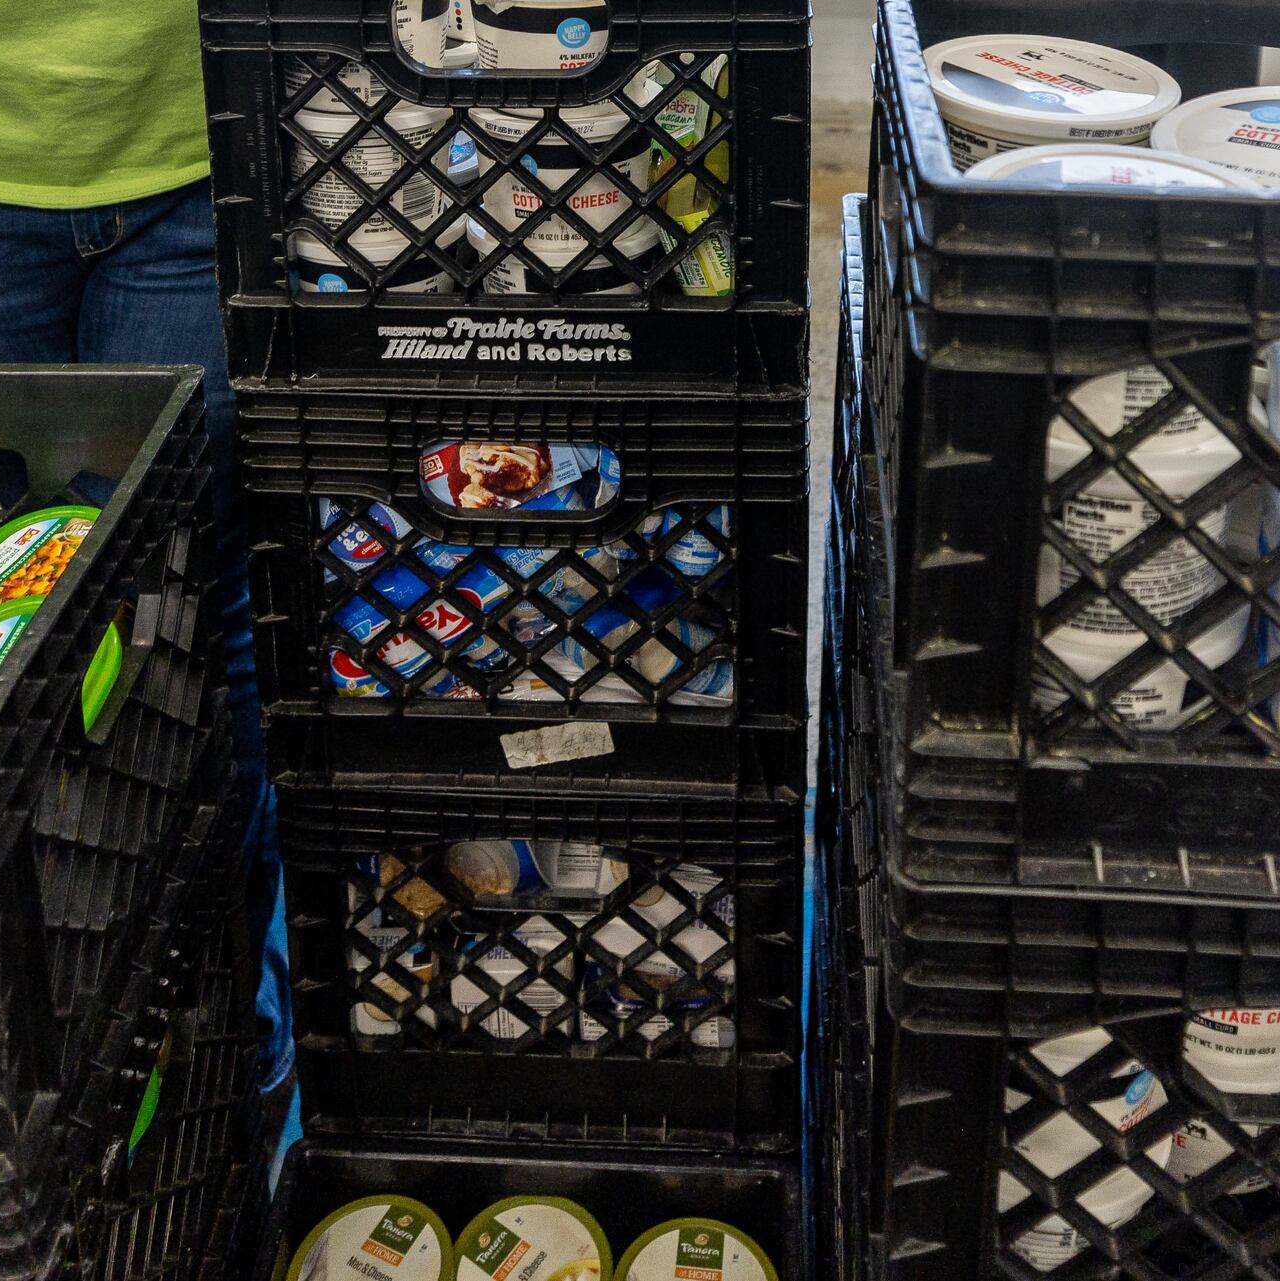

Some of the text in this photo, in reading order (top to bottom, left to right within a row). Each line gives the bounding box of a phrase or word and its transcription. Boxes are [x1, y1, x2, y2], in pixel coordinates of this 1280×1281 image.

[567, 31, 587, 40] BELLY
[570, 53, 596, 61] MILKFAT
[976, 51, 1032, 72] CHEESE
[1032, 66, 1095, 96] COTTAGE
[485, 122, 494, 130] BEST
[497, 125, 508, 133] USED
[1070, 127, 1085, 137] BEST
[949, 127, 988, 149] Nutrition
[949, 138, 972, 153] Facts
[513, 190, 619, 210] COTT CHEESE
[538, 233, 545, 241] 16
[546, 233, 554, 241] OZ
[378, 326, 432, 337] PROPERTY
[432, 326, 448, 338] OF
[447, 318, 535, 339] Prairie
[381, 339, 633, 362] Hiland and Roberts
[1067, 506, 1106, 522] Facts
[18, 528, 41, 546] Dole
[33, 523, 62, 550] PINEAPPLE
[342, 538, 359, 552] &
[1, 546, 37, 579] FIRECRACKER
[1199, 1038, 1213, 1049] WT.
[1214, 1043, 1224, 1052] 16
[1224, 1045, 1236, 1053] OZ
[382, 1218, 414, 1242] Panera
[373, 1244, 400, 1265] HOME
[476, 1230, 508, 1264] Panera
[681, 1242, 720, 1257] Panera
[346, 1255, 393, 1281] Mac & Cheese
[506, 1245, 529, 1272] HOME
[518, 1250, 548, 1281] & Cheese
[687, 1269, 720, 1281] HOME
